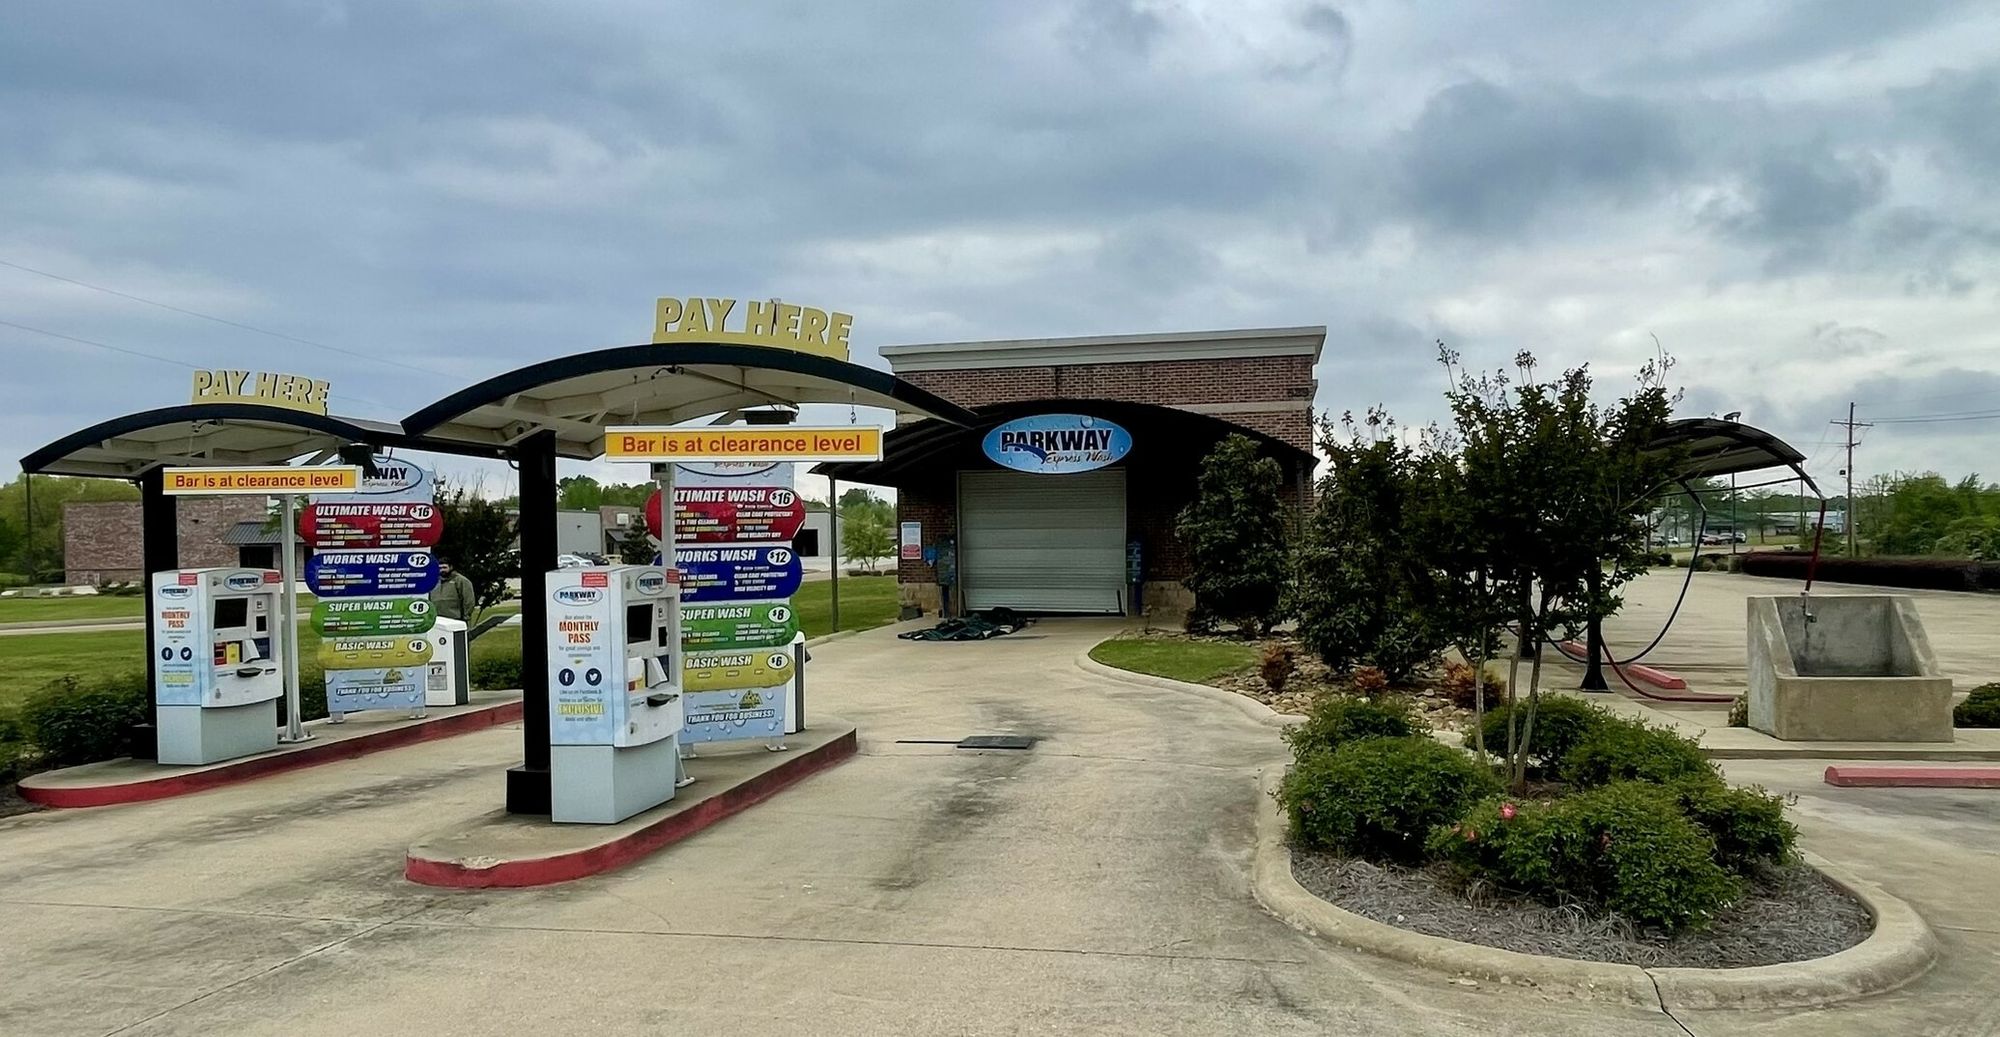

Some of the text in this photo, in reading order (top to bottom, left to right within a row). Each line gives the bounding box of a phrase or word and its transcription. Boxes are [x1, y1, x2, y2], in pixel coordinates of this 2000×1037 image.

[656, 297, 853, 348] PAY HERE
[194, 370, 331, 405] PAY HERE
[622, 434, 861, 453] Bar is at clearance level
[1001, 429, 1114, 452] PARKWAY
[1045, 451, 1114, 466] Express Wash
[175, 473, 344, 487] Bar is at clearance level
[674, 489, 791, 505] LTIMATE WASH $16
[316, 505, 430, 518] ULTIMATE WASH $16
[323, 553, 427, 566] WORKS WASH $12
[675, 549, 788, 563] WORKS WASH $12
[560, 591, 596, 599] PARKWAY
[328, 601, 361, 612] SUPER
[363, 601, 393, 611] WASH
[679, 607, 785, 620] SUPER WASH $8
[168, 620, 184, 628] PASS
[559, 621, 599, 632] MONTHLY
[568, 633, 591, 644] PASS
[334, 641, 365, 652] BASIC
[365, 640, 394, 650] WASH
[685, 655, 783, 669] BASIC WASH $6
[687, 710, 774, 724] THANK YOU FOR BUSINESS!
